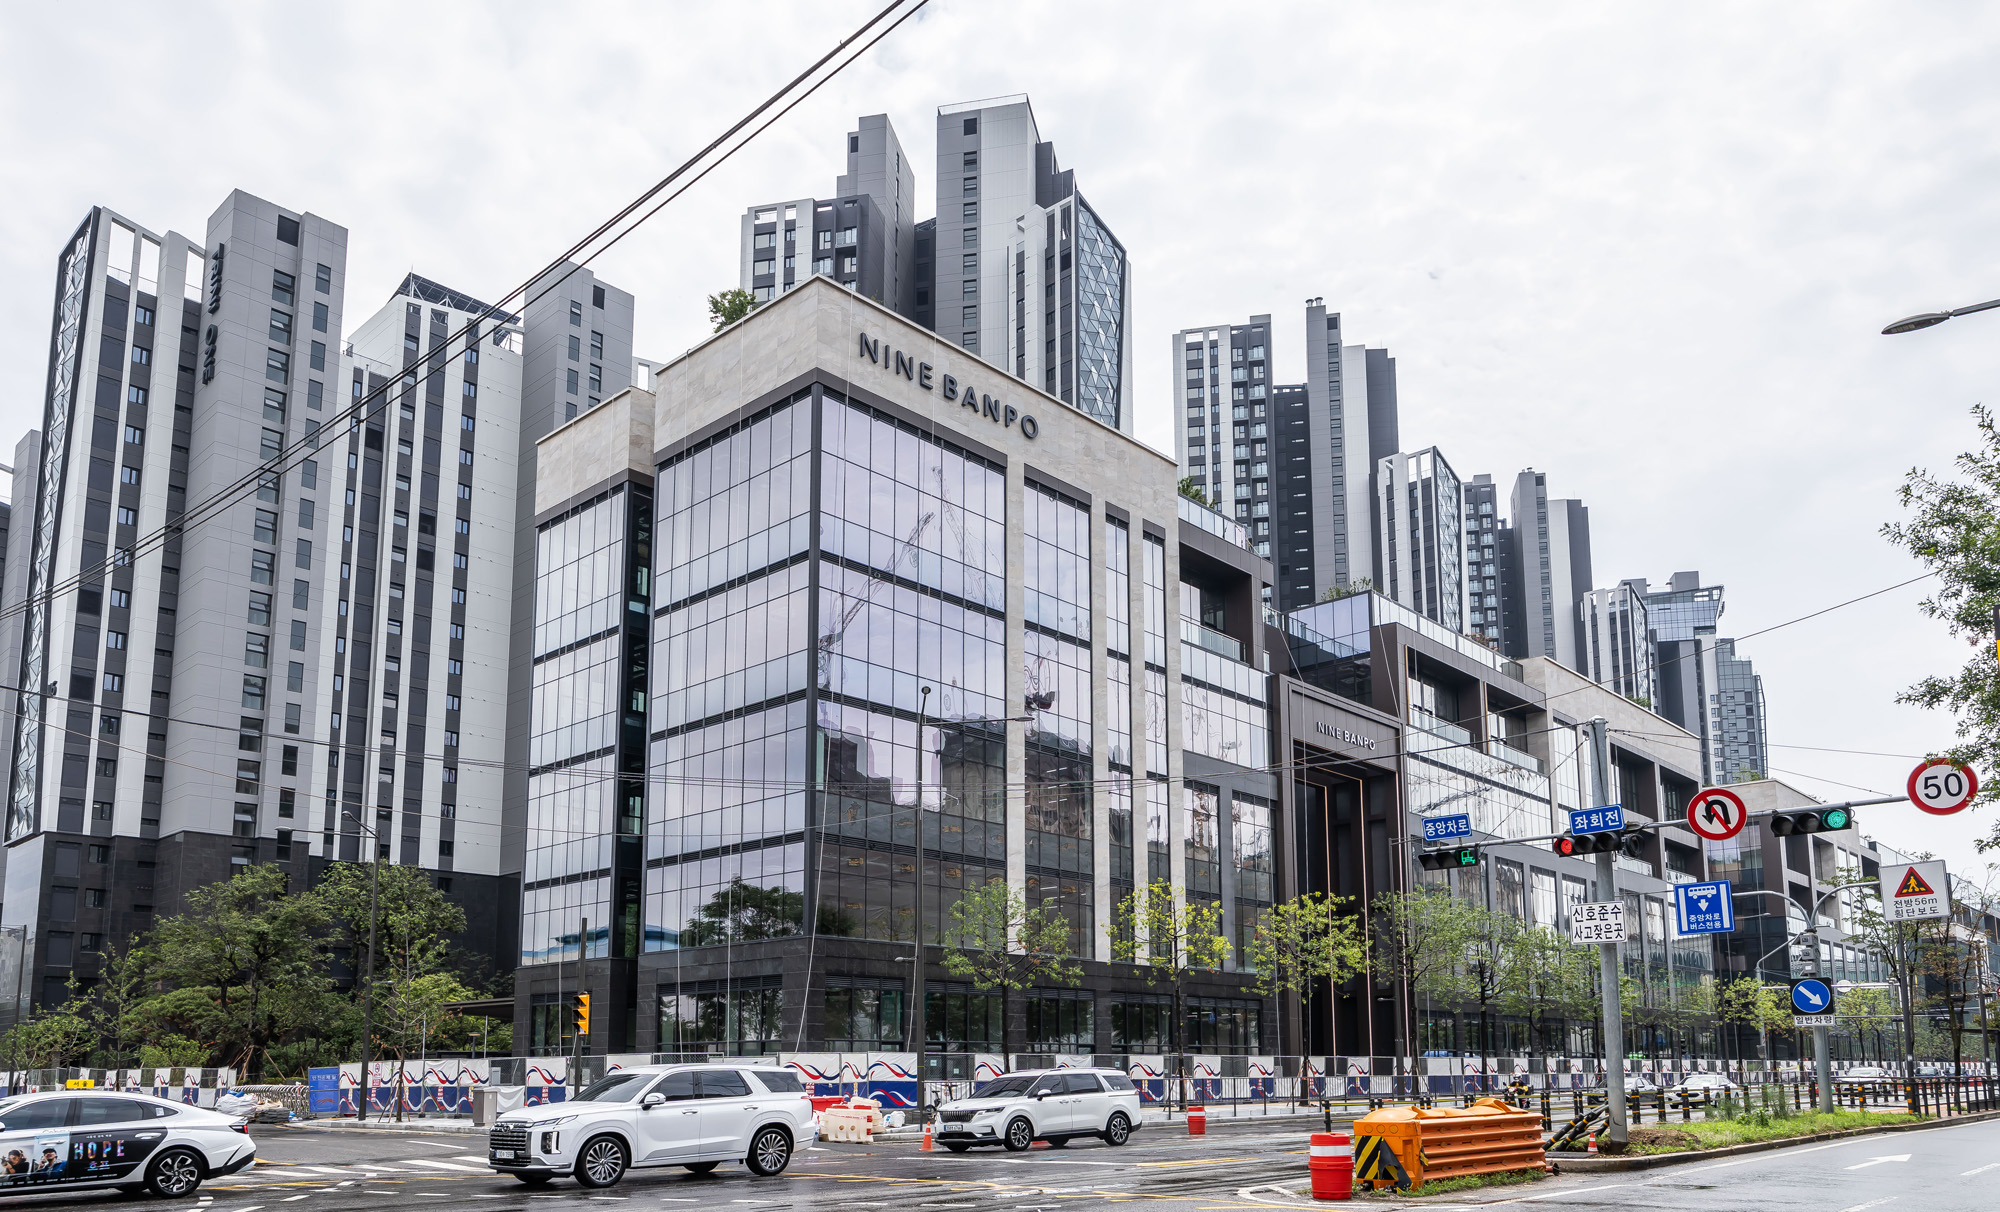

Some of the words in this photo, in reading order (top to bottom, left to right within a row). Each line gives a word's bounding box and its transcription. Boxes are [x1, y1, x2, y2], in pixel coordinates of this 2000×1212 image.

[202, 323, 218, 385] ONE
[860, 332, 933, 390] NINE
[943, 373, 1039, 439] BANPO
[1317, 721, 1341, 739] NINE
[1344, 730, 1376, 750] BANPO
[1923, 773, 1963, 799] 50
[1425, 819, 1469, 837] 중앙차로
[1574, 809, 1620, 830] 좌회전
[1573, 904, 1622, 923] 신호준수
[1689, 912, 1721, 923] 중앙차로
[1894, 906, 1939, 919] 횡단보도
[1690, 920, 1721, 930] 버스전용
[1795, 1015, 1832, 1024] 일반차량
[73, 1139, 125, 1160] HOPE
